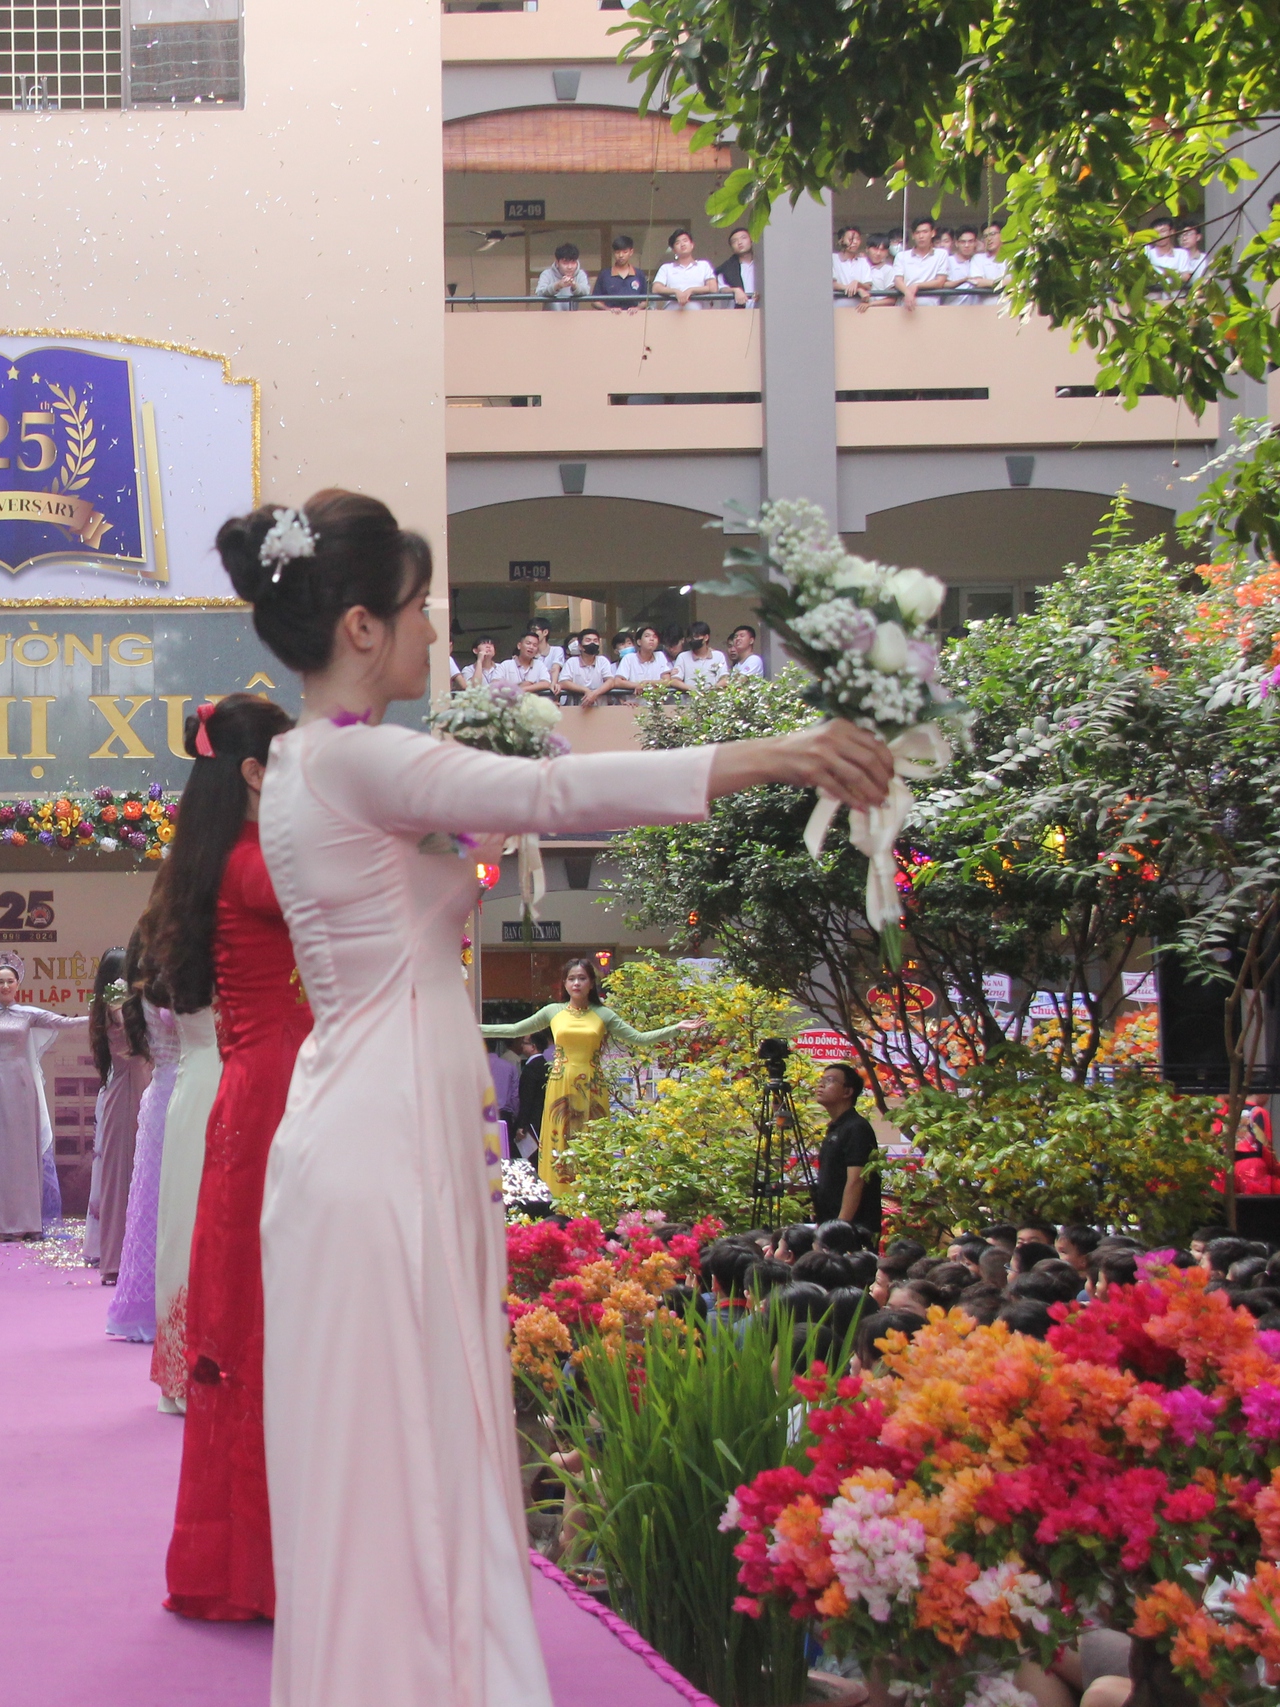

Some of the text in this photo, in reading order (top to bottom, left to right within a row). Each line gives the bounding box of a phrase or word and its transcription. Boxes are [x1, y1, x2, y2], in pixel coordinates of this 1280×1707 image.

[508, 204, 542, 217] A2-09
[513, 565, 547, 577] A1-09
[29, 932, 54, 940] 2024
[39, 985, 72, 1006] LẬP
[825, 1046, 852, 1057] MỪNG
